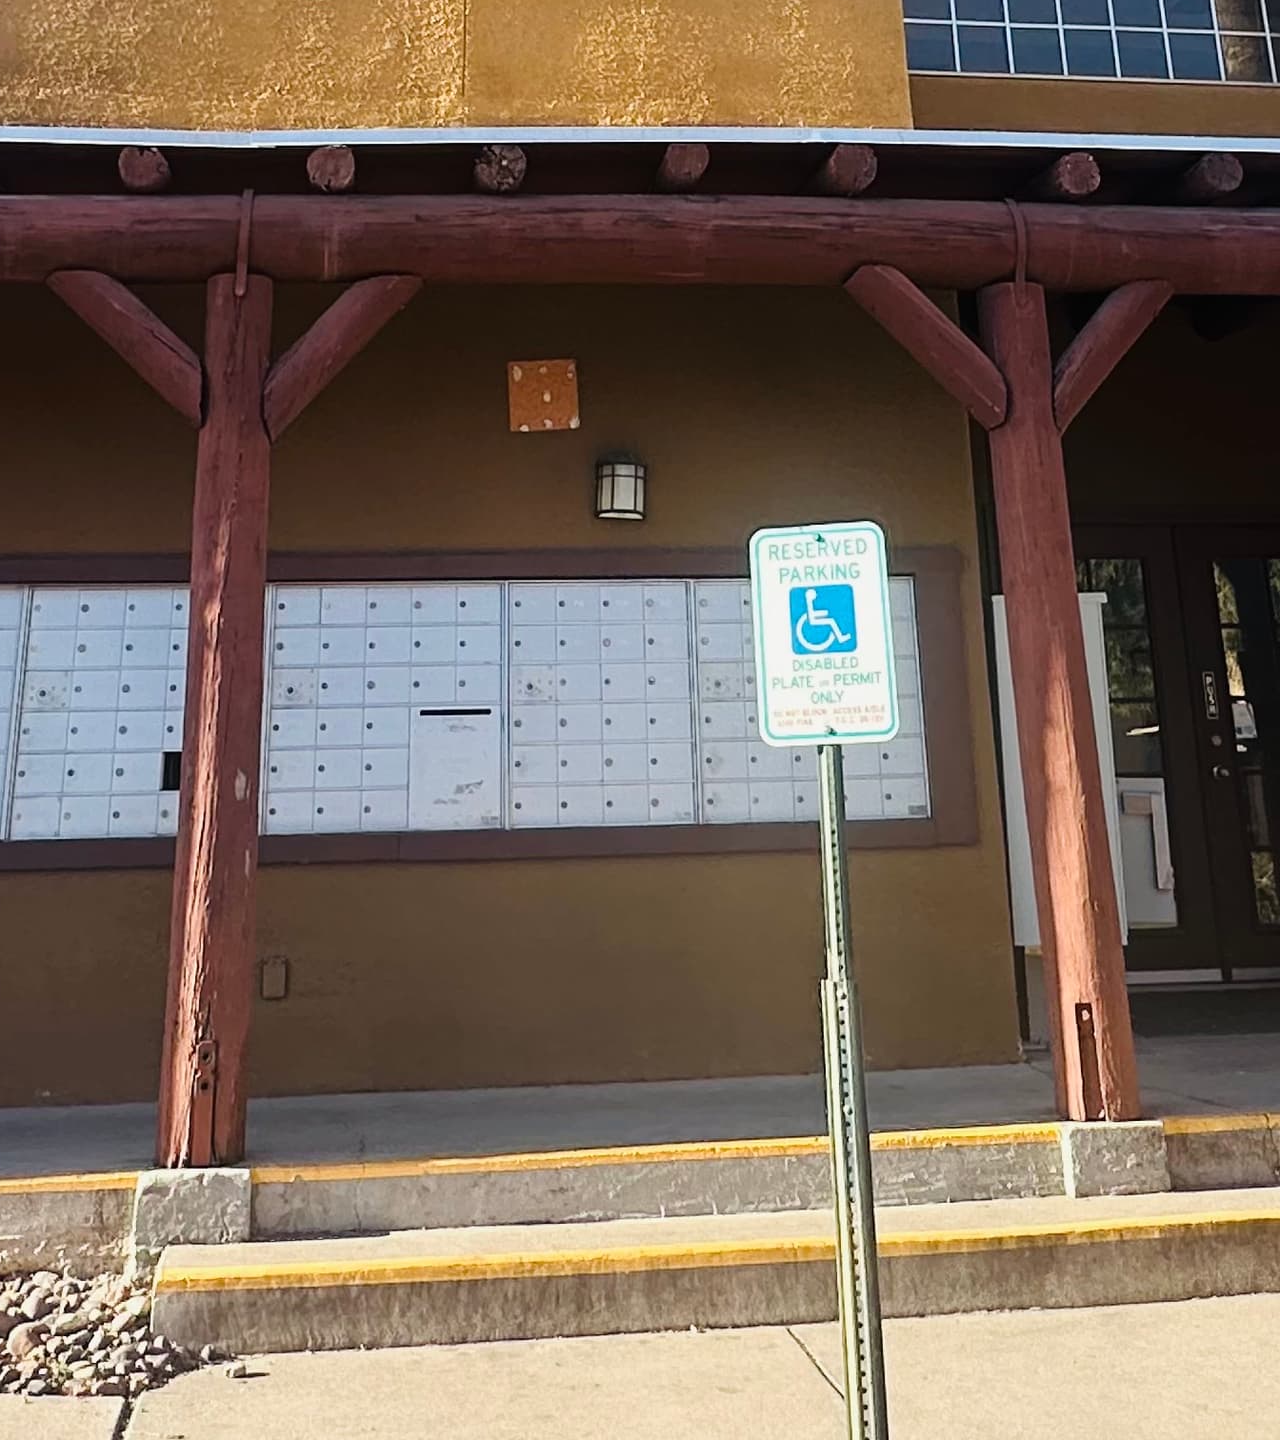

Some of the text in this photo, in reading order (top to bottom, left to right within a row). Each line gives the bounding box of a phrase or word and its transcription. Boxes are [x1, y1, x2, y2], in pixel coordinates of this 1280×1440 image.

[768, 538, 867, 560] RESERVED
[779, 562, 861, 584] PARKING
[792, 656, 859, 672] DISABLED
[772, 675, 815, 689] PLATE
[833, 672, 881, 686] PERMIT
[810, 690, 844, 704] ONLY
